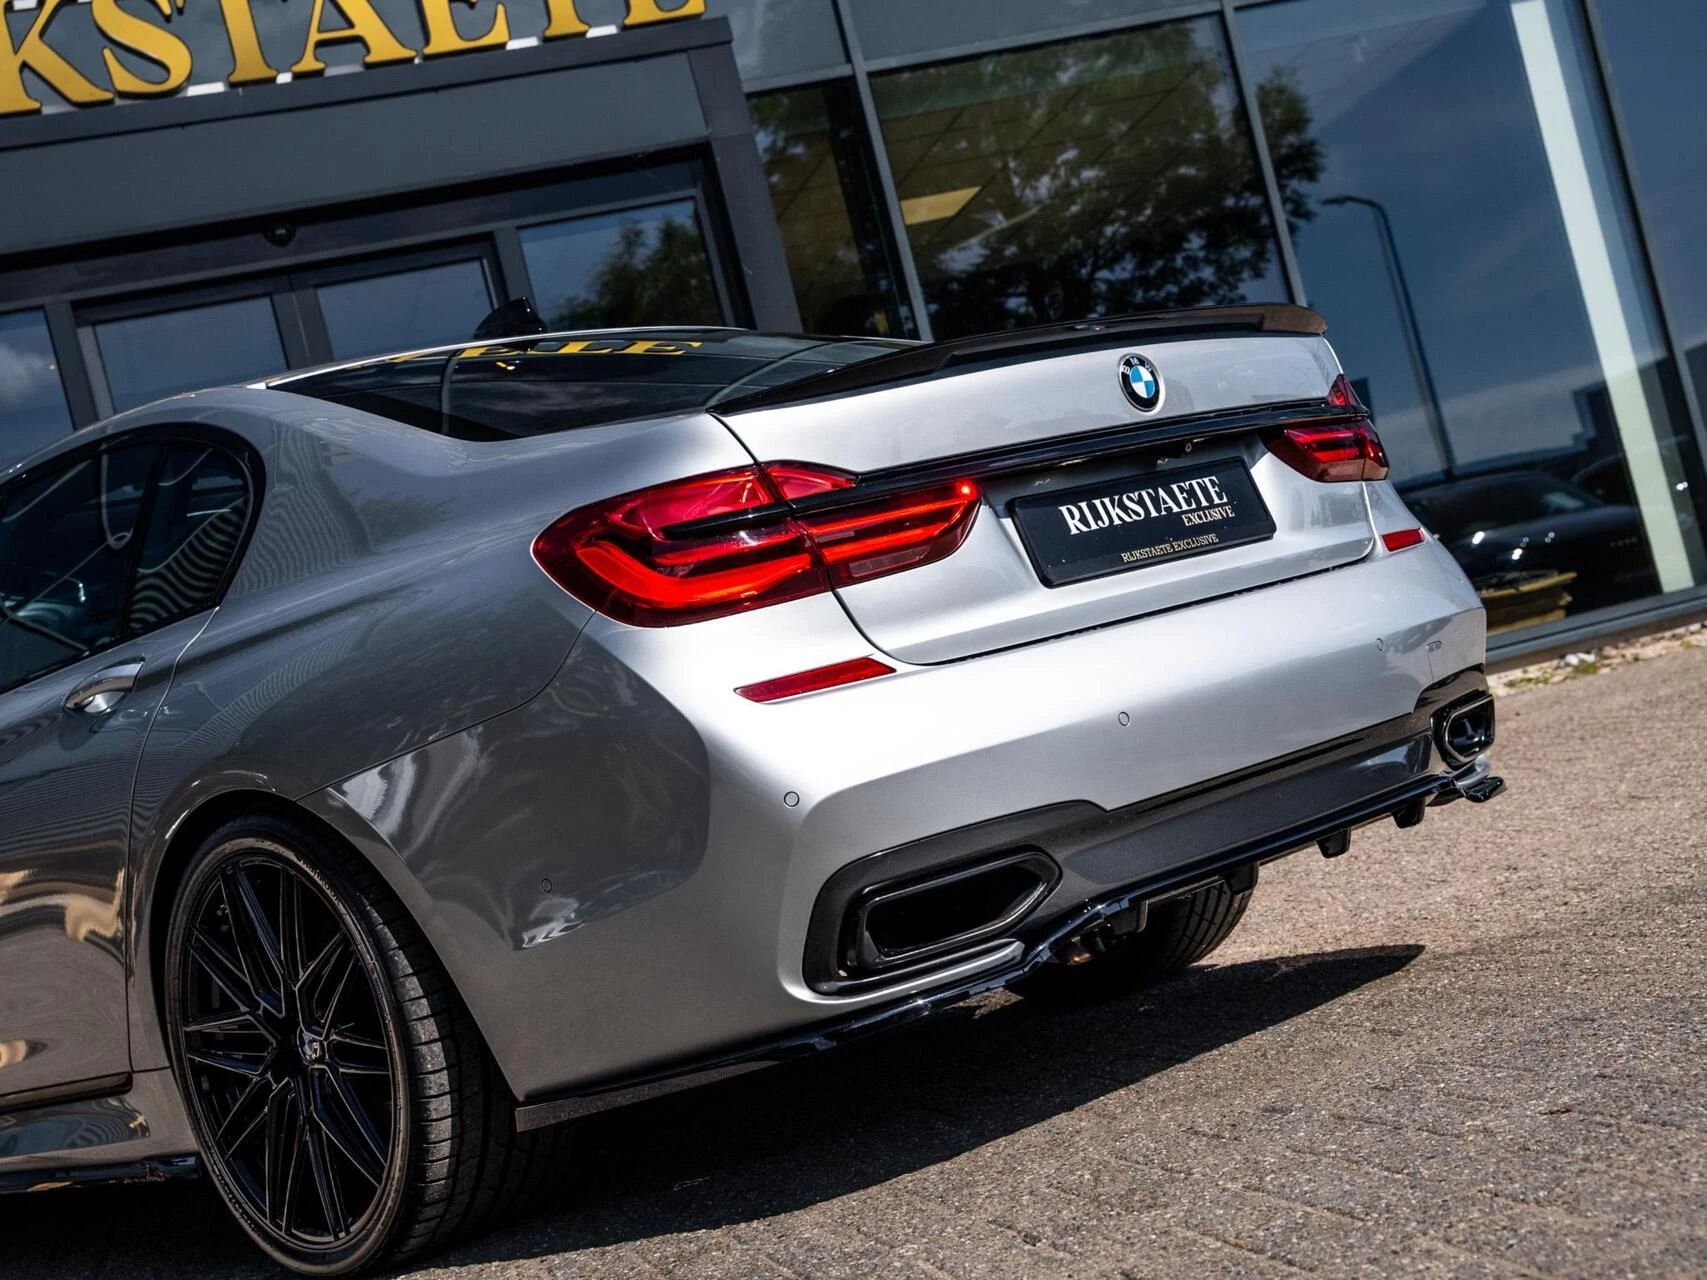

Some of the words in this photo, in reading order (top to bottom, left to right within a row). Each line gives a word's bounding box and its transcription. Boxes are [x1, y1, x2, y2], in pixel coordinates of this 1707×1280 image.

[1121, 356, 1153, 376] BMW
[1057, 475, 1228, 535] RIJKSTAETE
[1181, 505, 1235, 527] EXCLUSIVE
[1120, 541, 1174, 563] RIJKSTAETE
[1172, 533, 1219, 553] EXCLUSIVE
